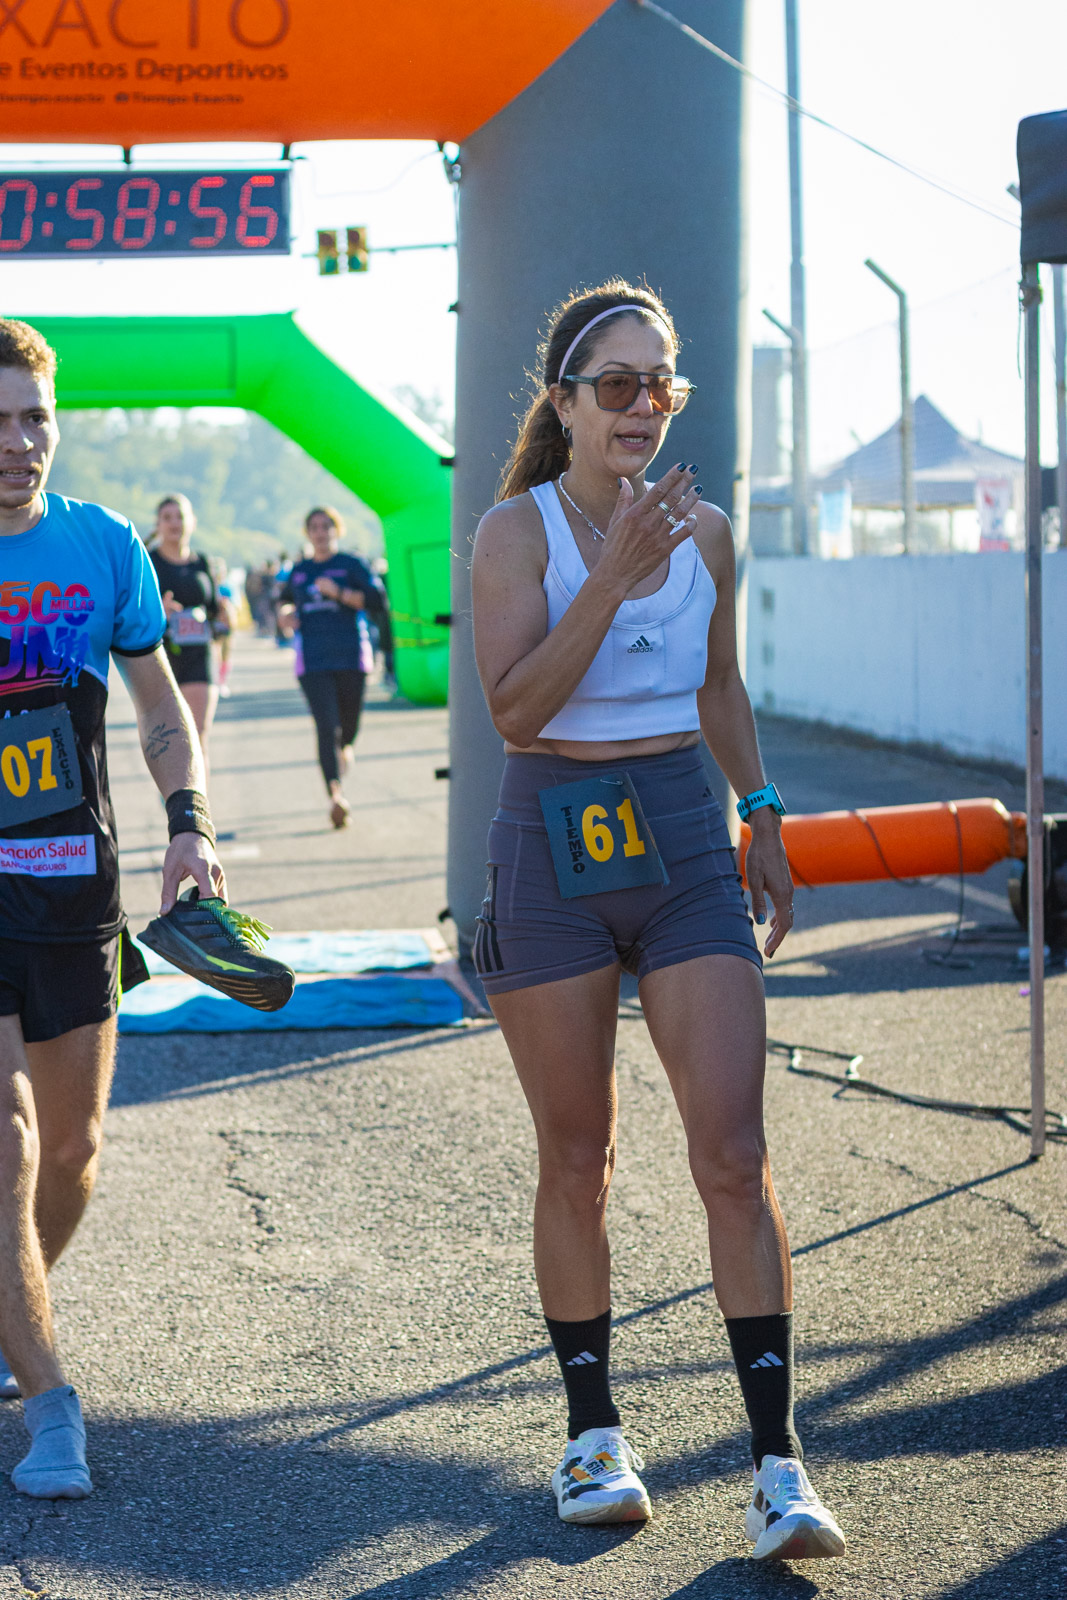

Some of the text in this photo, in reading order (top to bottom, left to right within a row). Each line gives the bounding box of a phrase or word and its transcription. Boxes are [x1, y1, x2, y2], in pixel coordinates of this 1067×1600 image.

[20, 57, 128, 80] Eventos
[136, 58, 288, 83] Deportivos
[50, 599, 95, 611] MILLAS
[1, 736, 58, 797] 07
[51, 727, 74, 790] EXACTO
[48, 840, 87, 858] Salud
[561, 806, 585, 874] TIEMPO
[582, 798, 645, 862] 61
[33, 863, 67, 872] SEGUROS
